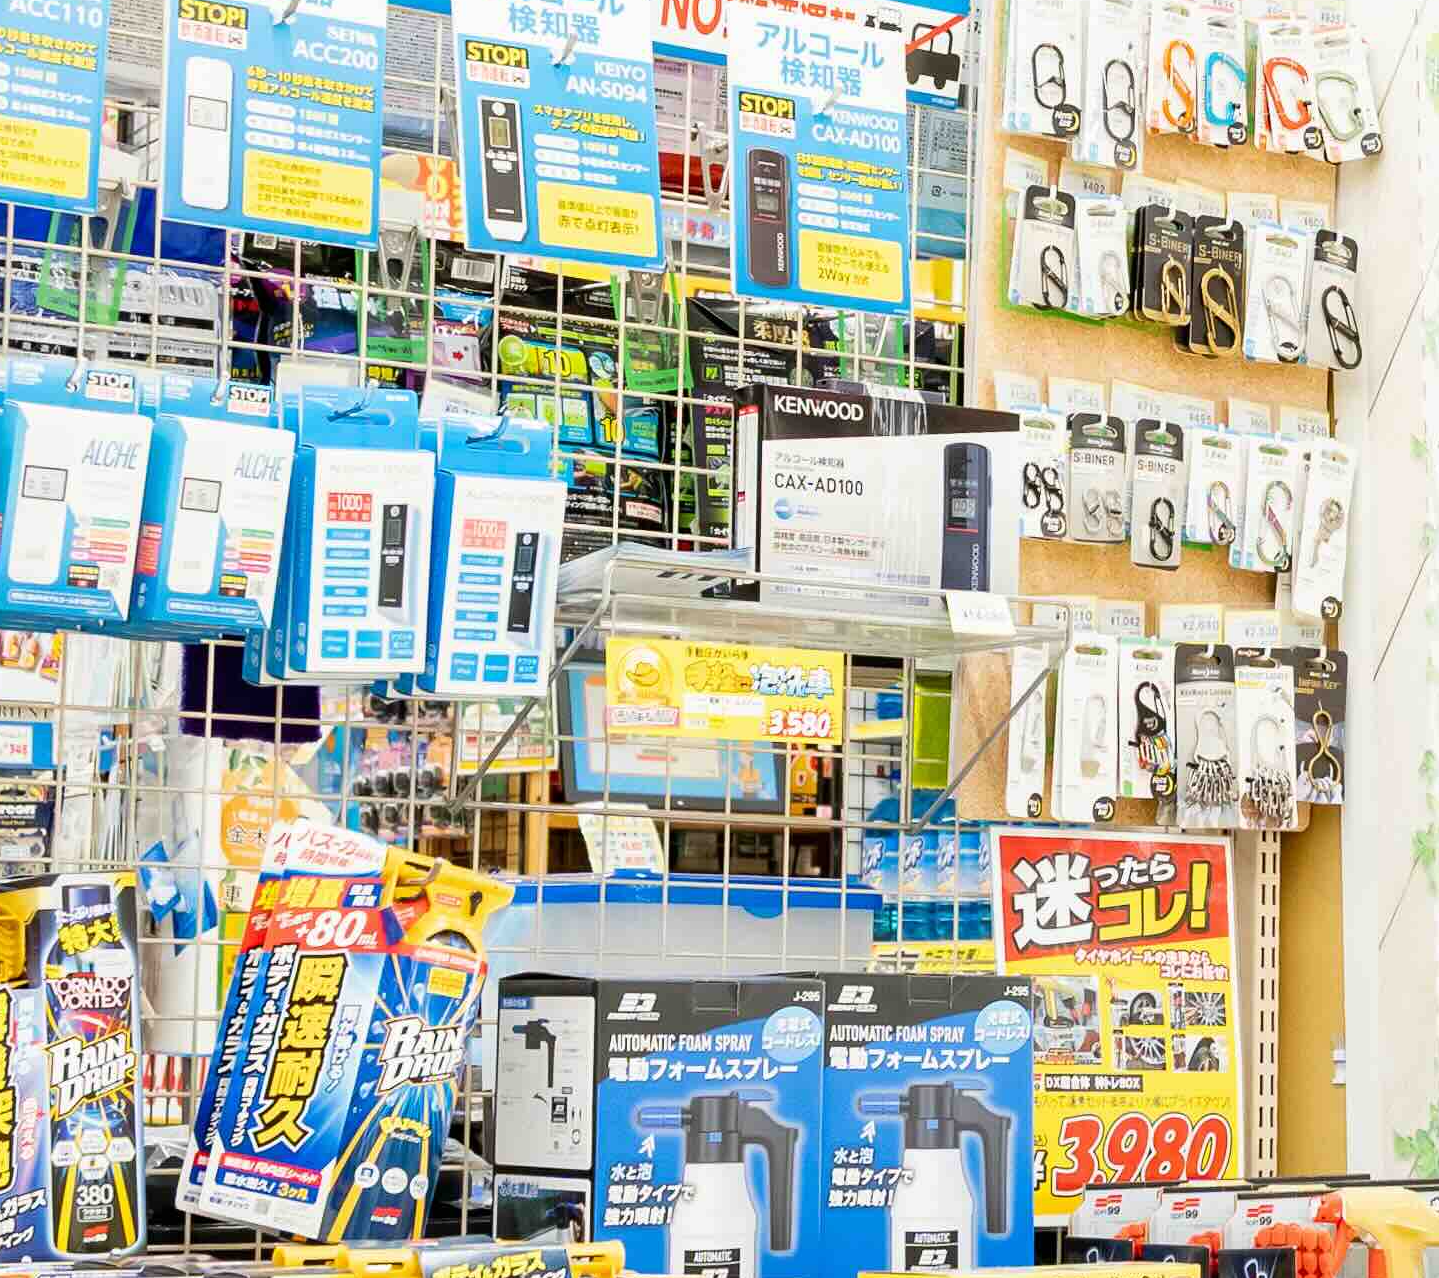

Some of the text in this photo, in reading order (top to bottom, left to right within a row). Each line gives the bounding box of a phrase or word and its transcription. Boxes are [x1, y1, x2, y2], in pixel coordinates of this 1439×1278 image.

[293, 39, 378, 71] ACC200
[773, 394, 864, 422] KENWOOD
[774, 475, 864, 496] CAX-AD100
